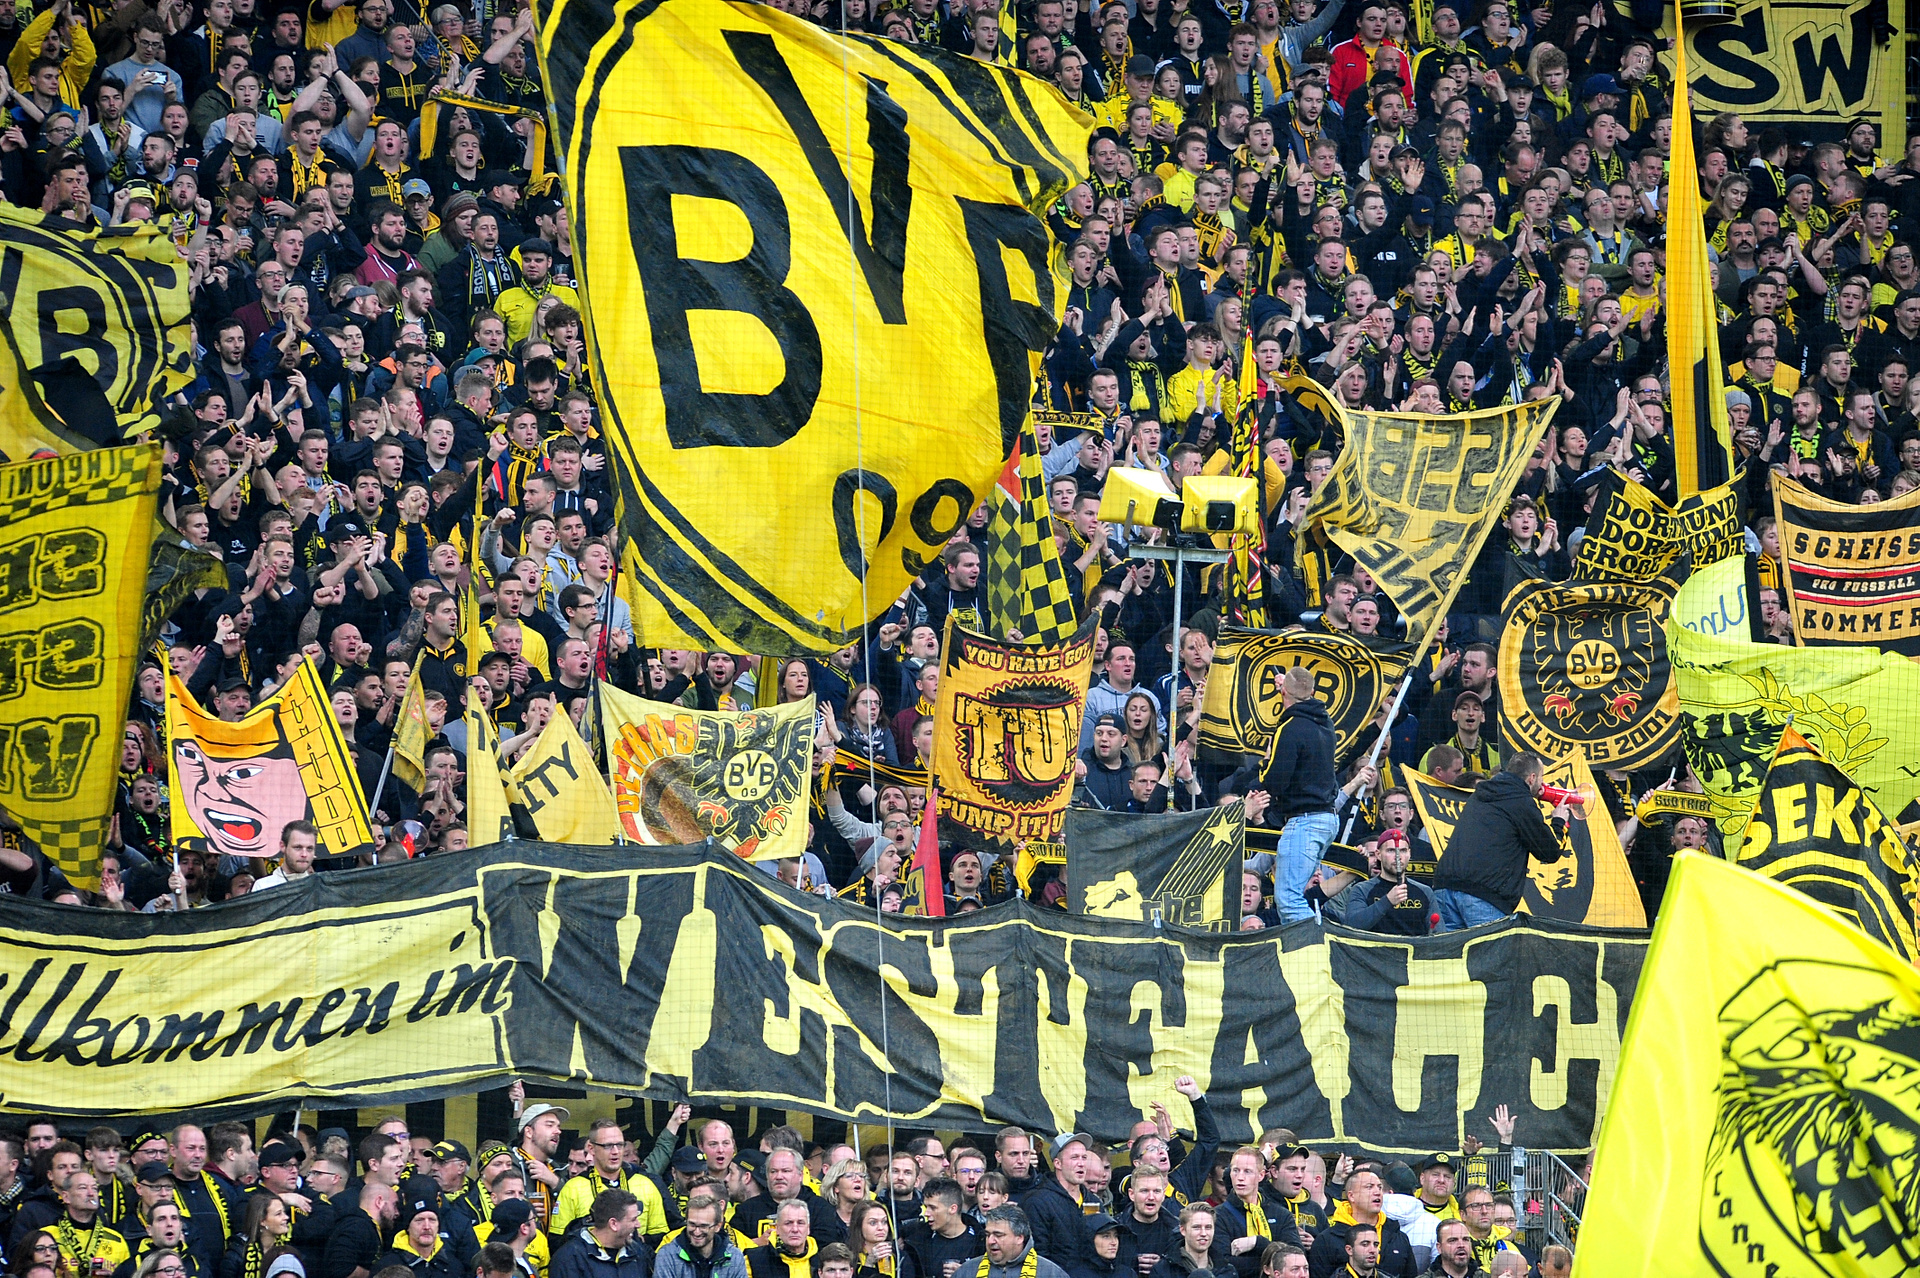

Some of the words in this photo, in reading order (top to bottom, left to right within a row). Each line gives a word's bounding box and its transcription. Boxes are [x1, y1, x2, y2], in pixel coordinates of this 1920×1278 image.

[1843, 575, 1916, 594] FUSSBALL
[1511, 588, 1577, 628] THE
[965, 643, 1004, 670] YOU
[1007, 651, 1061, 673] HAVE
[1572, 643, 1617, 675] BVB
[1584, 675, 1601, 685] 09
[1516, 710, 1610, 760] ULTRAS
[1614, 708, 1673, 756] 2001
[613, 713, 698, 814] ULTRAS
[728, 752, 777, 787] BVB
[741, 787, 758, 798] 09
[937, 796, 1014, 836] PUMP
[1019, 813, 1050, 838] IT
[0, 957, 399, 1068] llkommen
[406, 929, 514, 1024] im
[480, 868, 1645, 1153] WESTFALE
